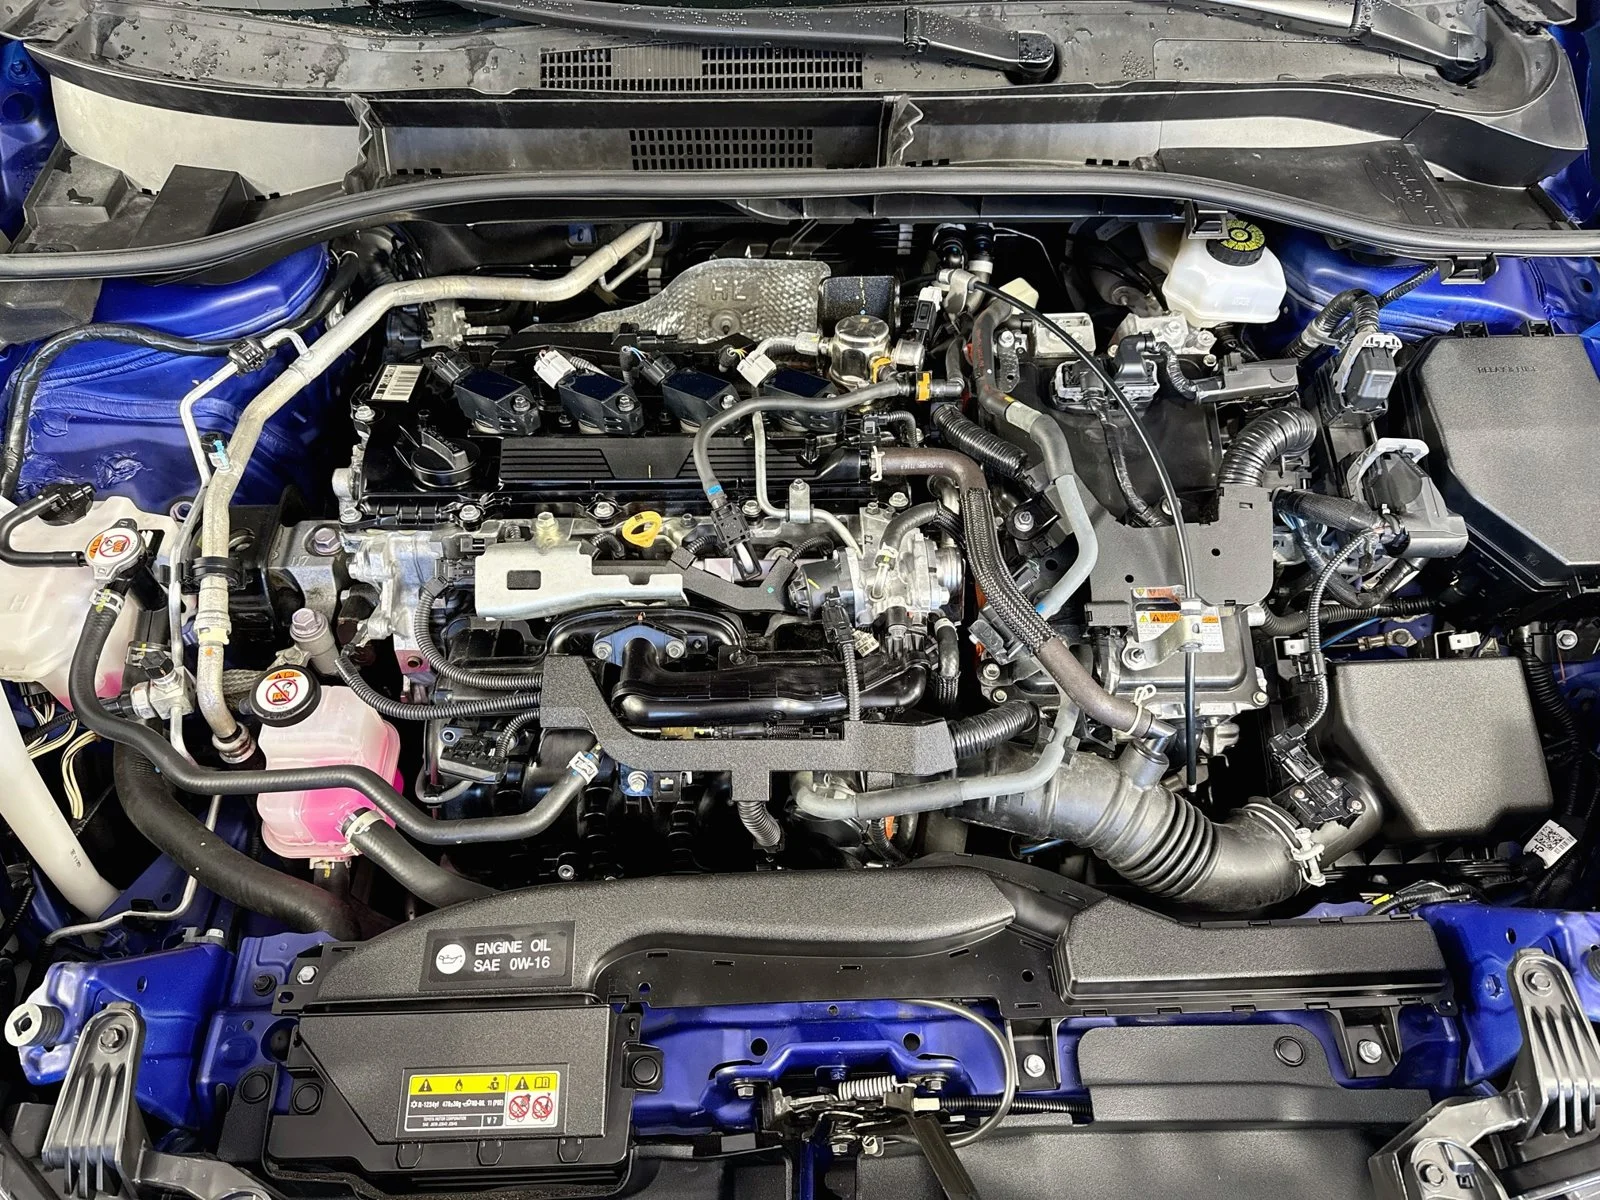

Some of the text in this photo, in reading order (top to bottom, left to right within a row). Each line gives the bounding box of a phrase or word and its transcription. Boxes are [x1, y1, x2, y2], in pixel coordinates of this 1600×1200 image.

[475, 939, 552, 956] ENGINE OIL
[474, 956, 550, 972] SAE 0W-16
